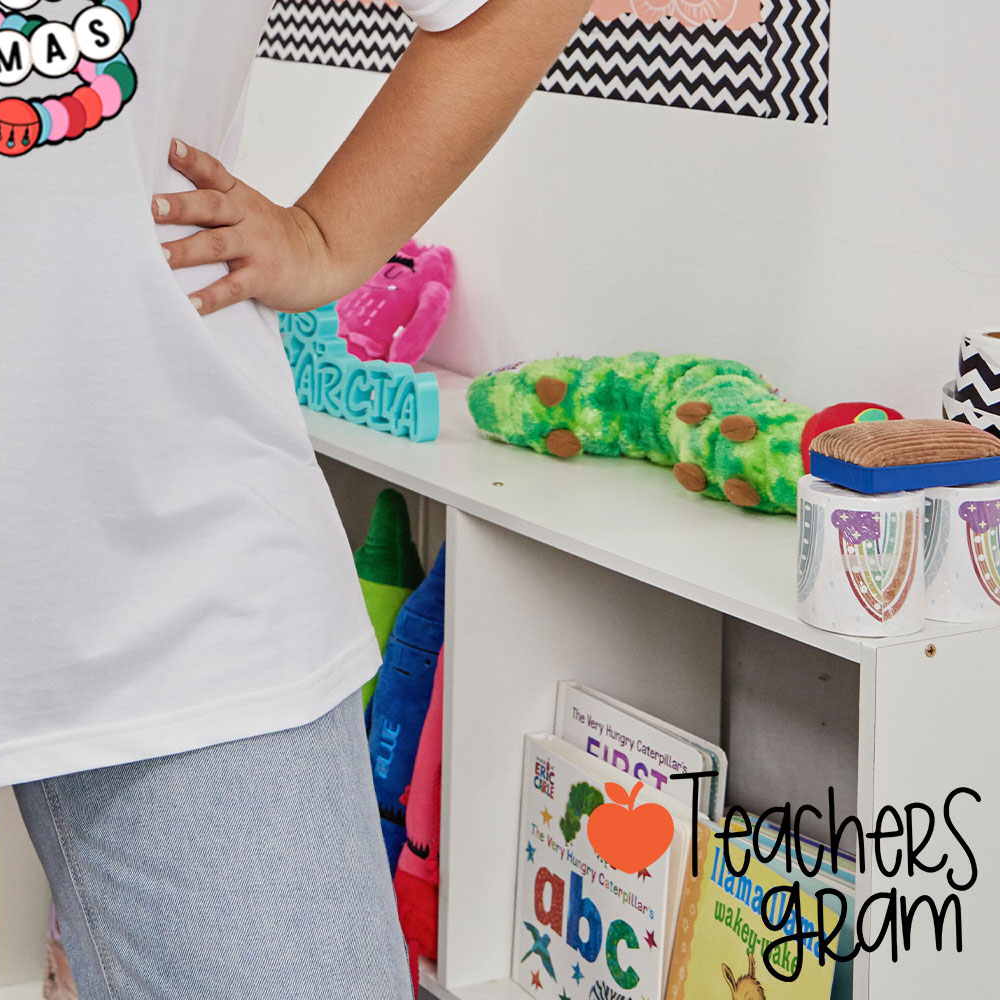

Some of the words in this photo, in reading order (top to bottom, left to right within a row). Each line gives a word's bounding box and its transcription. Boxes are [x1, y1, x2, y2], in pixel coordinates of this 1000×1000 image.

[375, 716, 401, 779] BLUE
[535, 761, 555, 785] ERIC
[572, 706, 586, 724] The
[586, 715, 604, 735] Very
[605, 724, 636, 751] Hungry
[636, 739, 688, 775] Caterpillar's
[534, 775, 555, 800] CARLE
[531, 822, 545, 842] The
[547, 834, 565, 860] Very
[566, 850, 597, 883] Hungry
[598, 873, 654, 920] Caterpillar's
[710, 846, 764, 915] llama
[534, 866, 640, 990] abc
